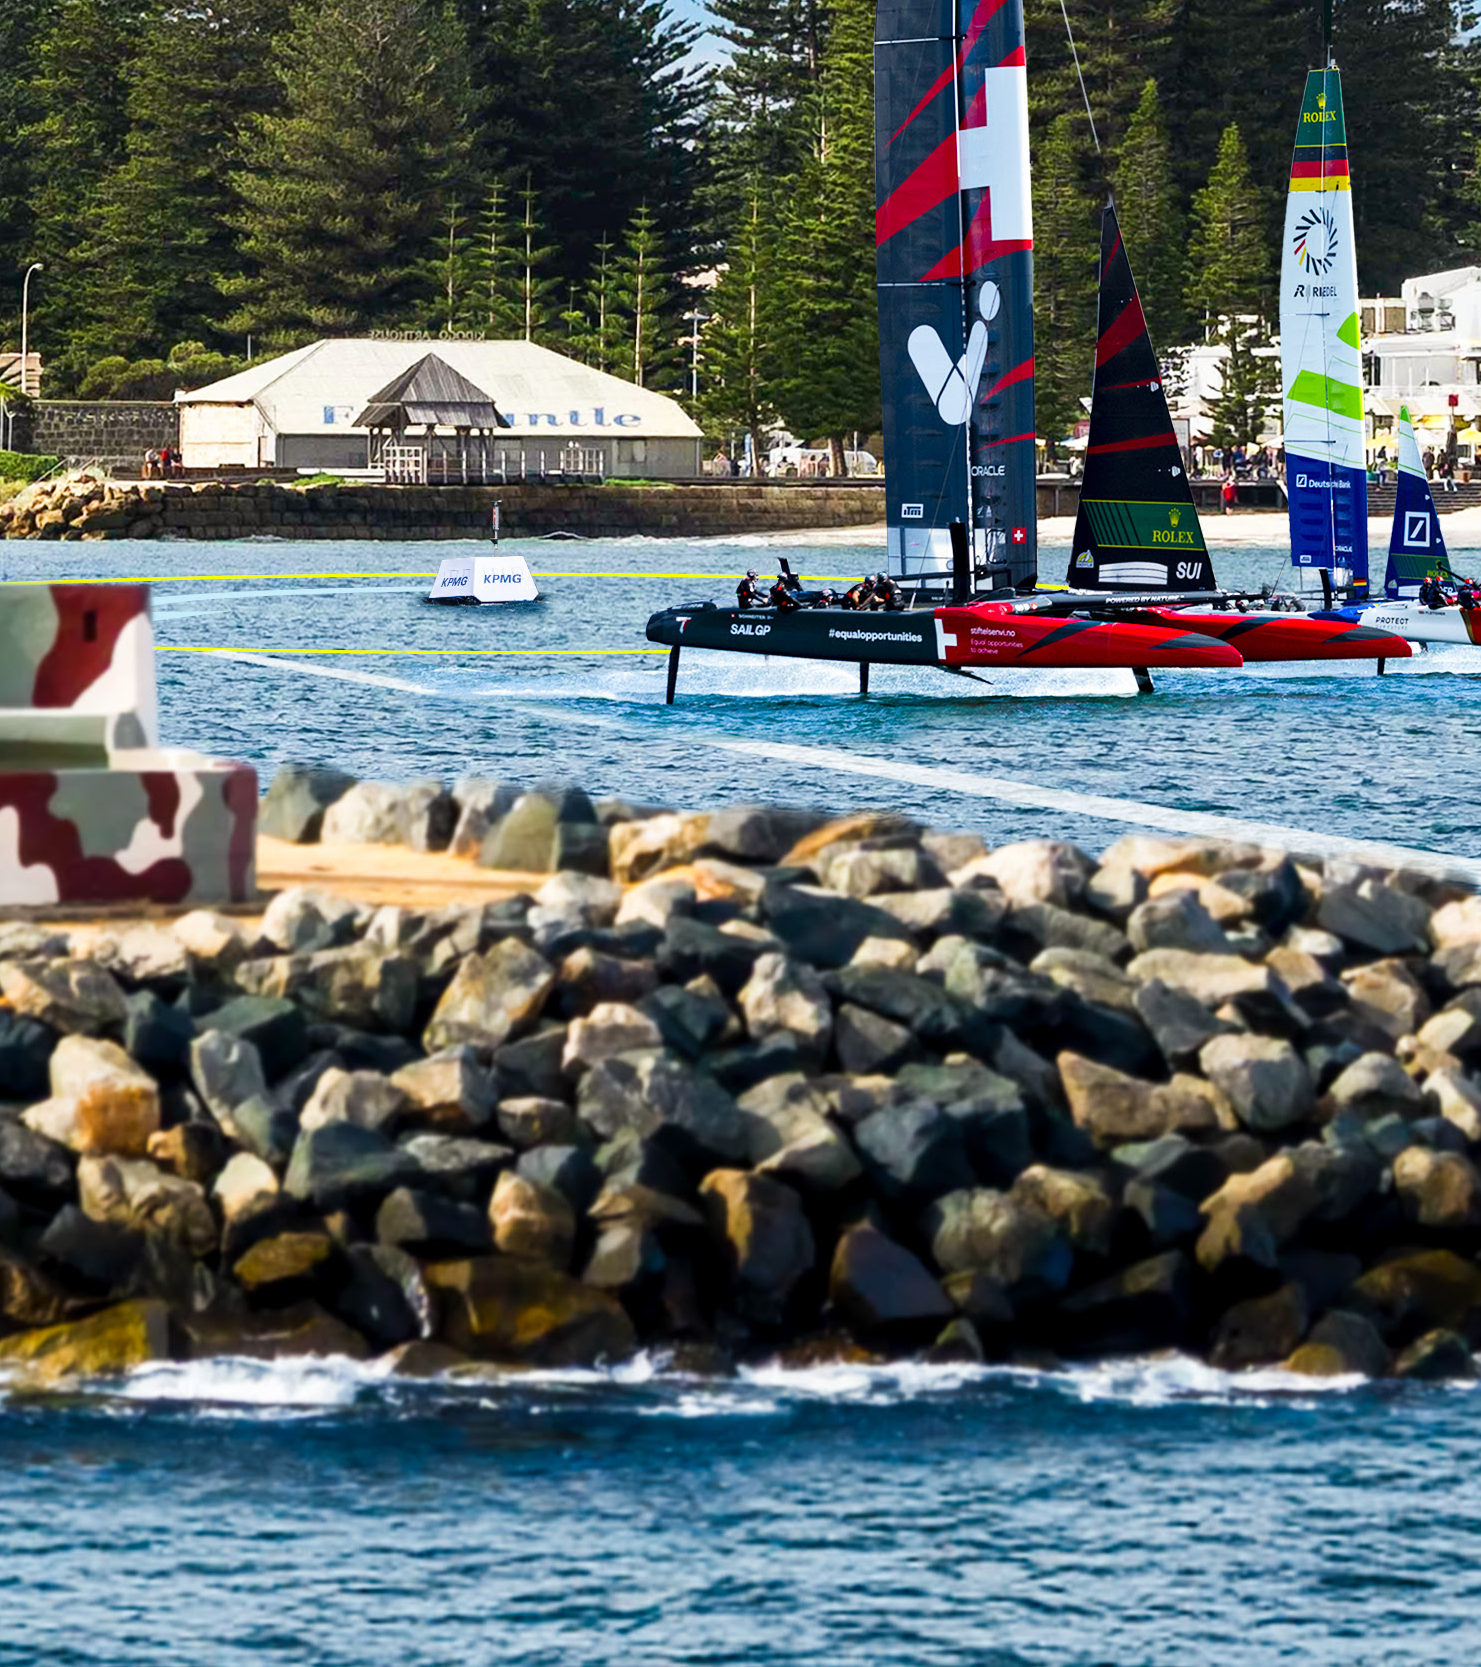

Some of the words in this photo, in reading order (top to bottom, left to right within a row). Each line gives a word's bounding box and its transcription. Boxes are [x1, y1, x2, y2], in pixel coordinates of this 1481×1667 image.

[1303, 110, 1337, 124] ROLEX
[1312, 285, 1338, 298] RIEDEL
[971, 465, 1006, 477] ORACLE
[1152, 530, 1195, 544] ROLEX
[1176, 561, 1203, 580] SUI
[441, 576, 469, 588] KPMG
[483, 573, 522, 584] KPMG
[1375, 616, 1409, 625] PROTECT
[730, 623, 772, 636] SAILGP
[828, 628, 923, 643] #equalopportunities
[970, 638, 987, 646] Equal
[987, 640, 1024, 648] opportunities
